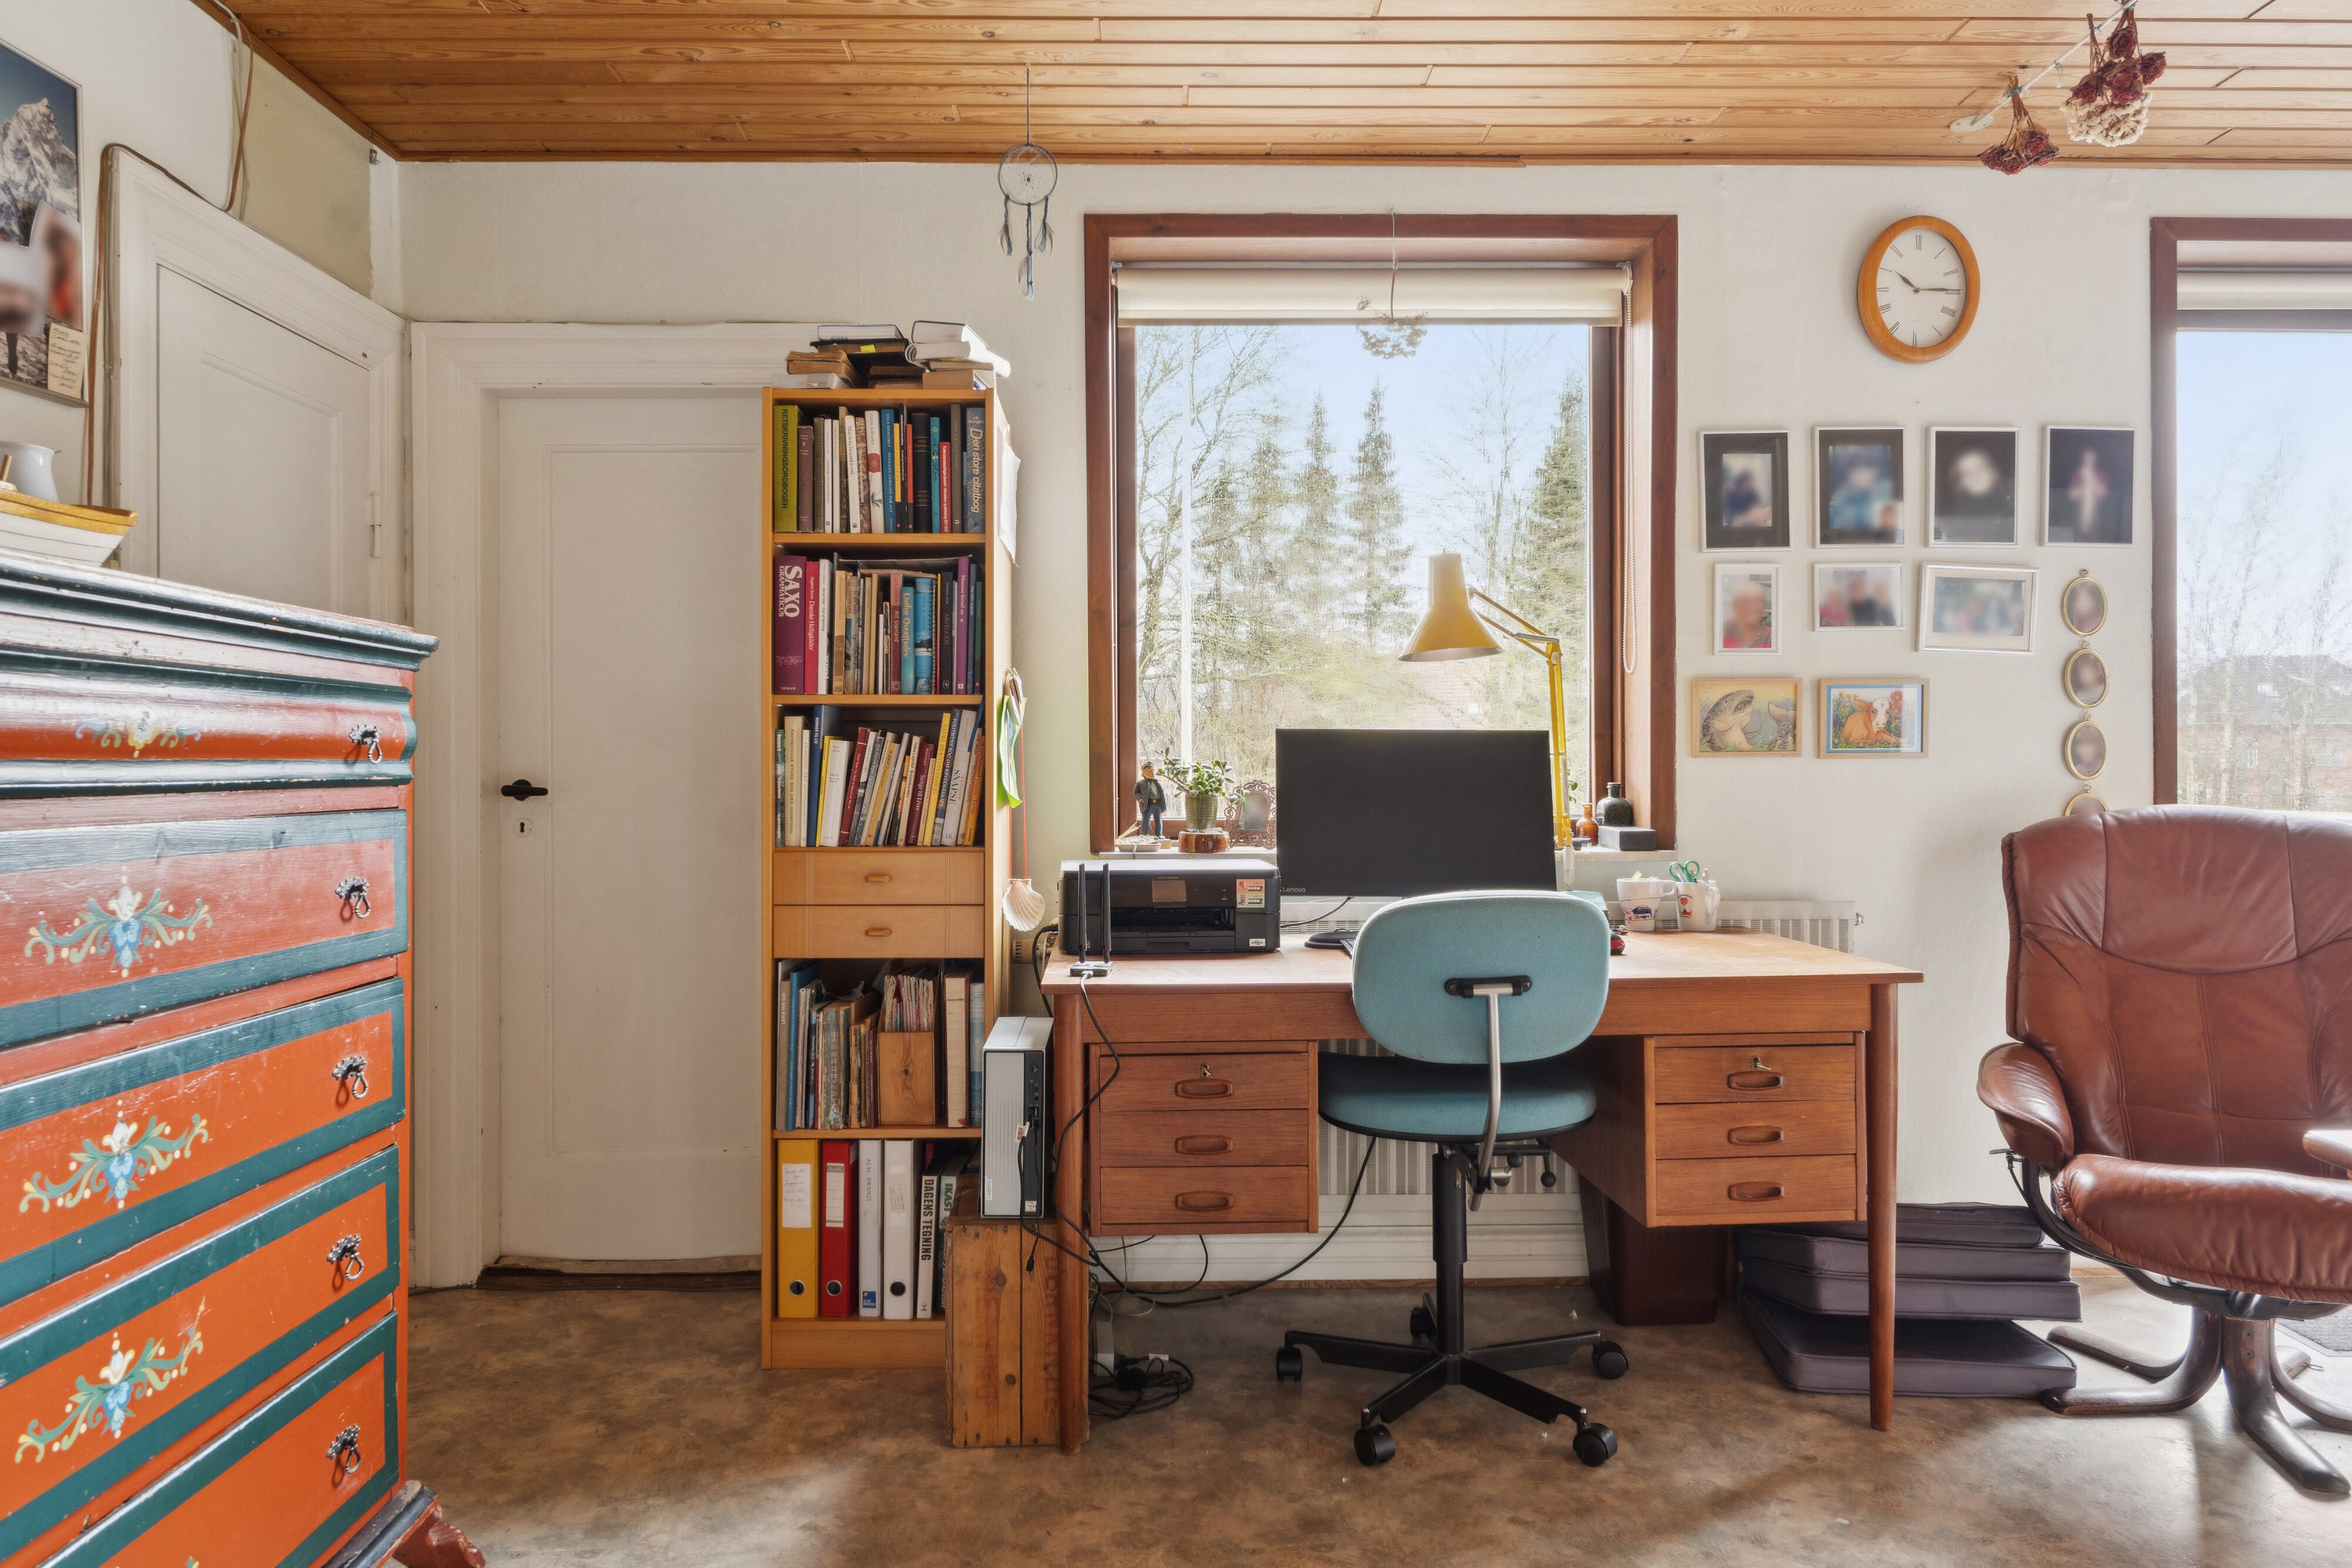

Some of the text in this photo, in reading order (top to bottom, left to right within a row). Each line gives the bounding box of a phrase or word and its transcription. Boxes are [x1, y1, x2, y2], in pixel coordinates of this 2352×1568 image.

[970, 427, 983, 451] Den
[971, 477, 982, 514] citatbog
[784, 565, 802, 617] SAXO
[948, 718, 957, 746] POLITIKENS
[933, 744, 945, 794] BRÆNDEVINSBOG
[946, 759, 951, 768] OM
[916, 775, 925, 790] Sange
[939, 768, 950, 808] KRYDDERSNAPS
[949, 769, 960, 805] SNAPSE
[943, 1183, 953, 1212] IKAST
[920, 1178, 935, 1261] DAGENS TEGNING
